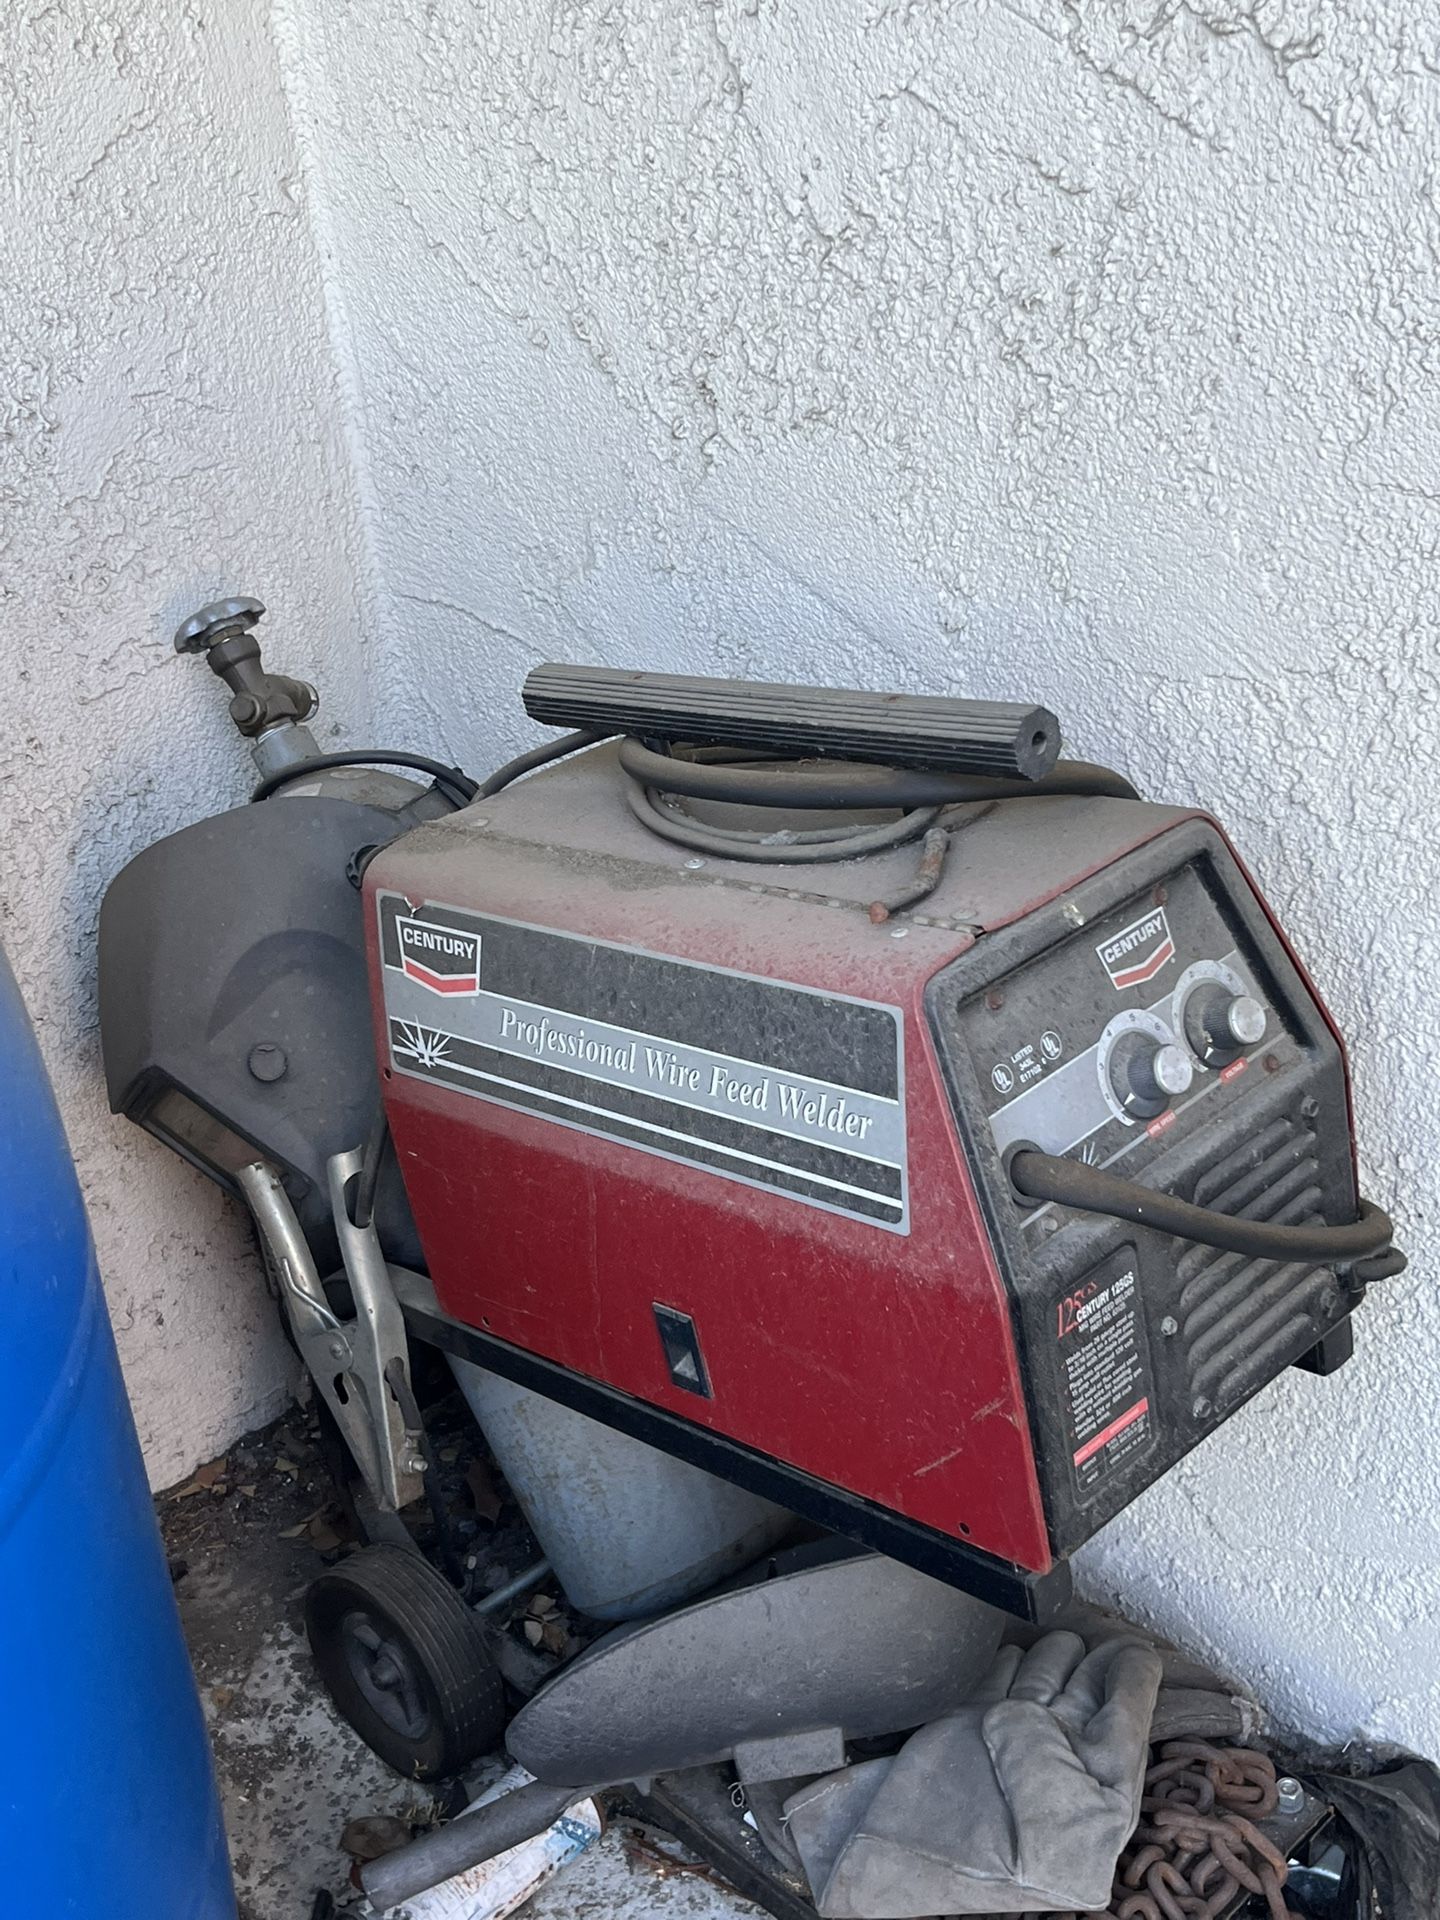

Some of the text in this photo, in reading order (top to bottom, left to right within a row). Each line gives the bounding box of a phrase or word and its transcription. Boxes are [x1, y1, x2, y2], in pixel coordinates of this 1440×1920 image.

[402, 925, 475, 960] CENTURY
[1103, 915, 1162, 963] CENTURY
[497, 1006, 874, 1140] Professional Wire Feed Welder
[1010, 1045, 1033, 1064] LISTED
[1076, 1271, 1134, 1323] CENTURY 125GS
